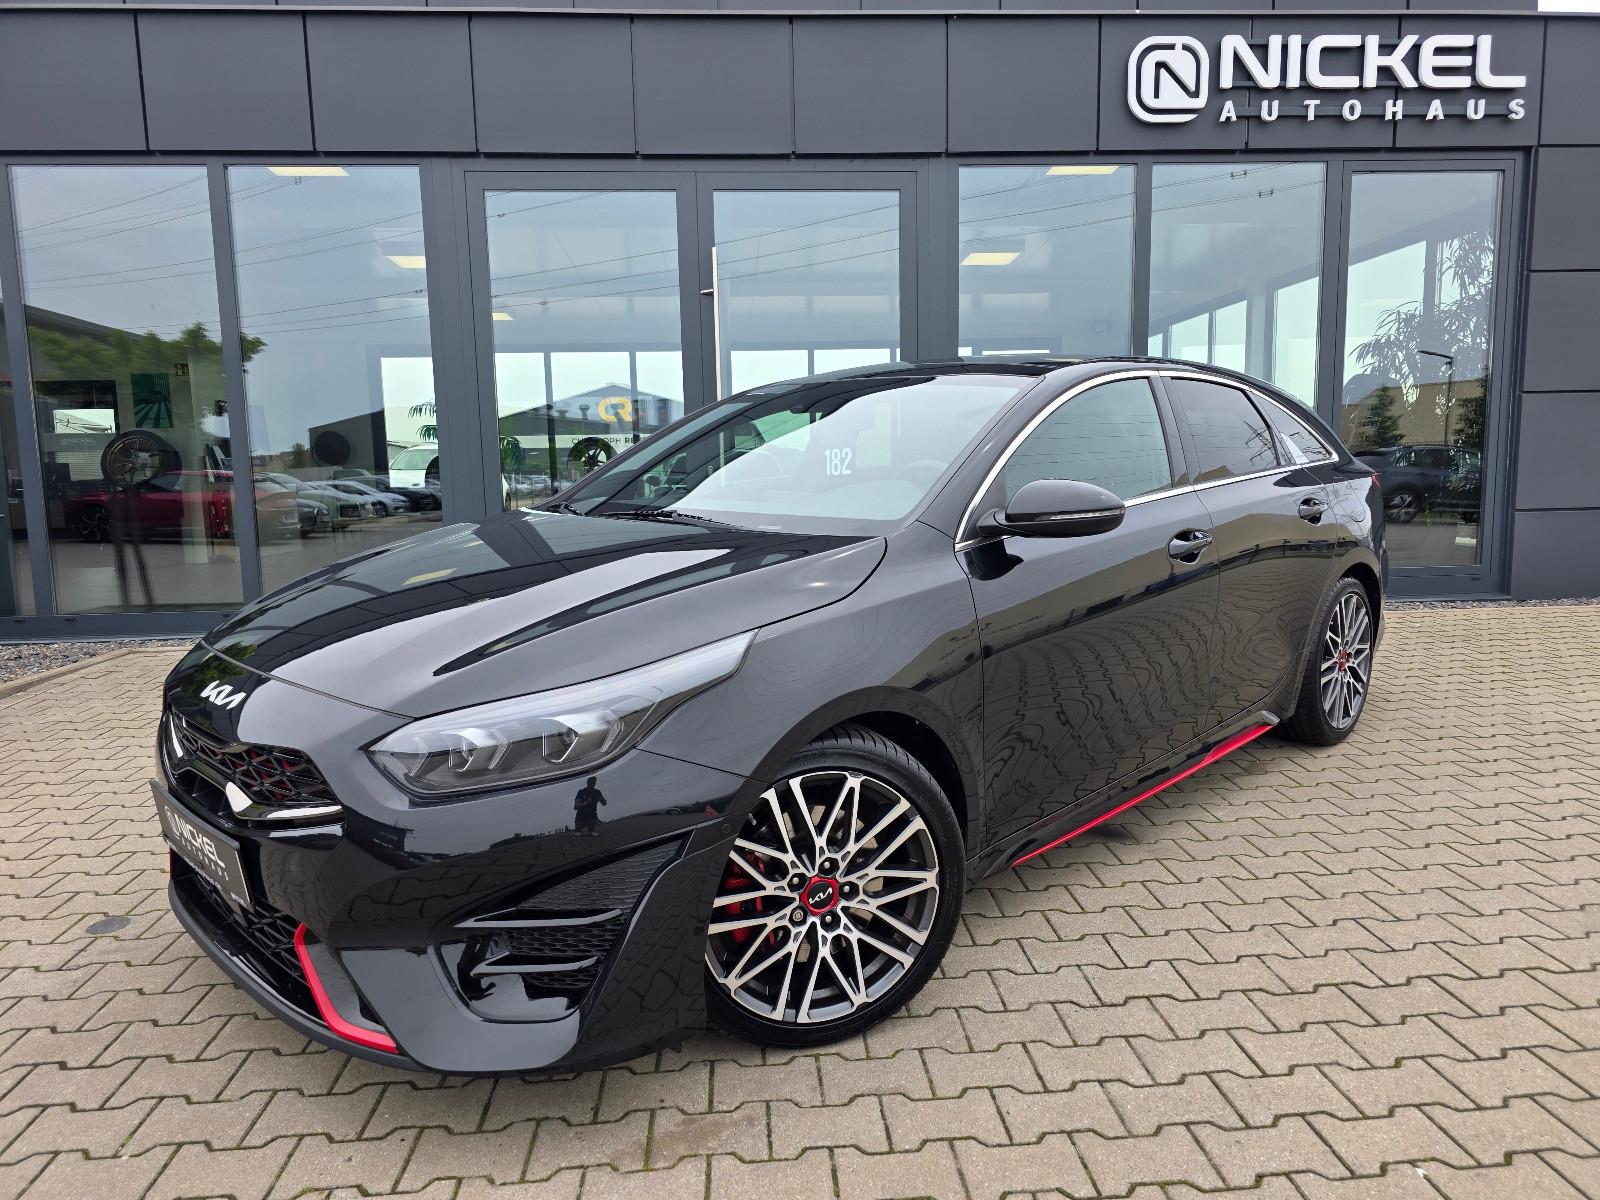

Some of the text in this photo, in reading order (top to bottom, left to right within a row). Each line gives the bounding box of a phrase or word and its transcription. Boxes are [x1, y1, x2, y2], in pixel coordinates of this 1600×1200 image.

[1219, 34, 1527, 90] NICKEL
[1218, 98, 1526, 123] AUTOHAUS
[824, 447, 852, 476] 182
